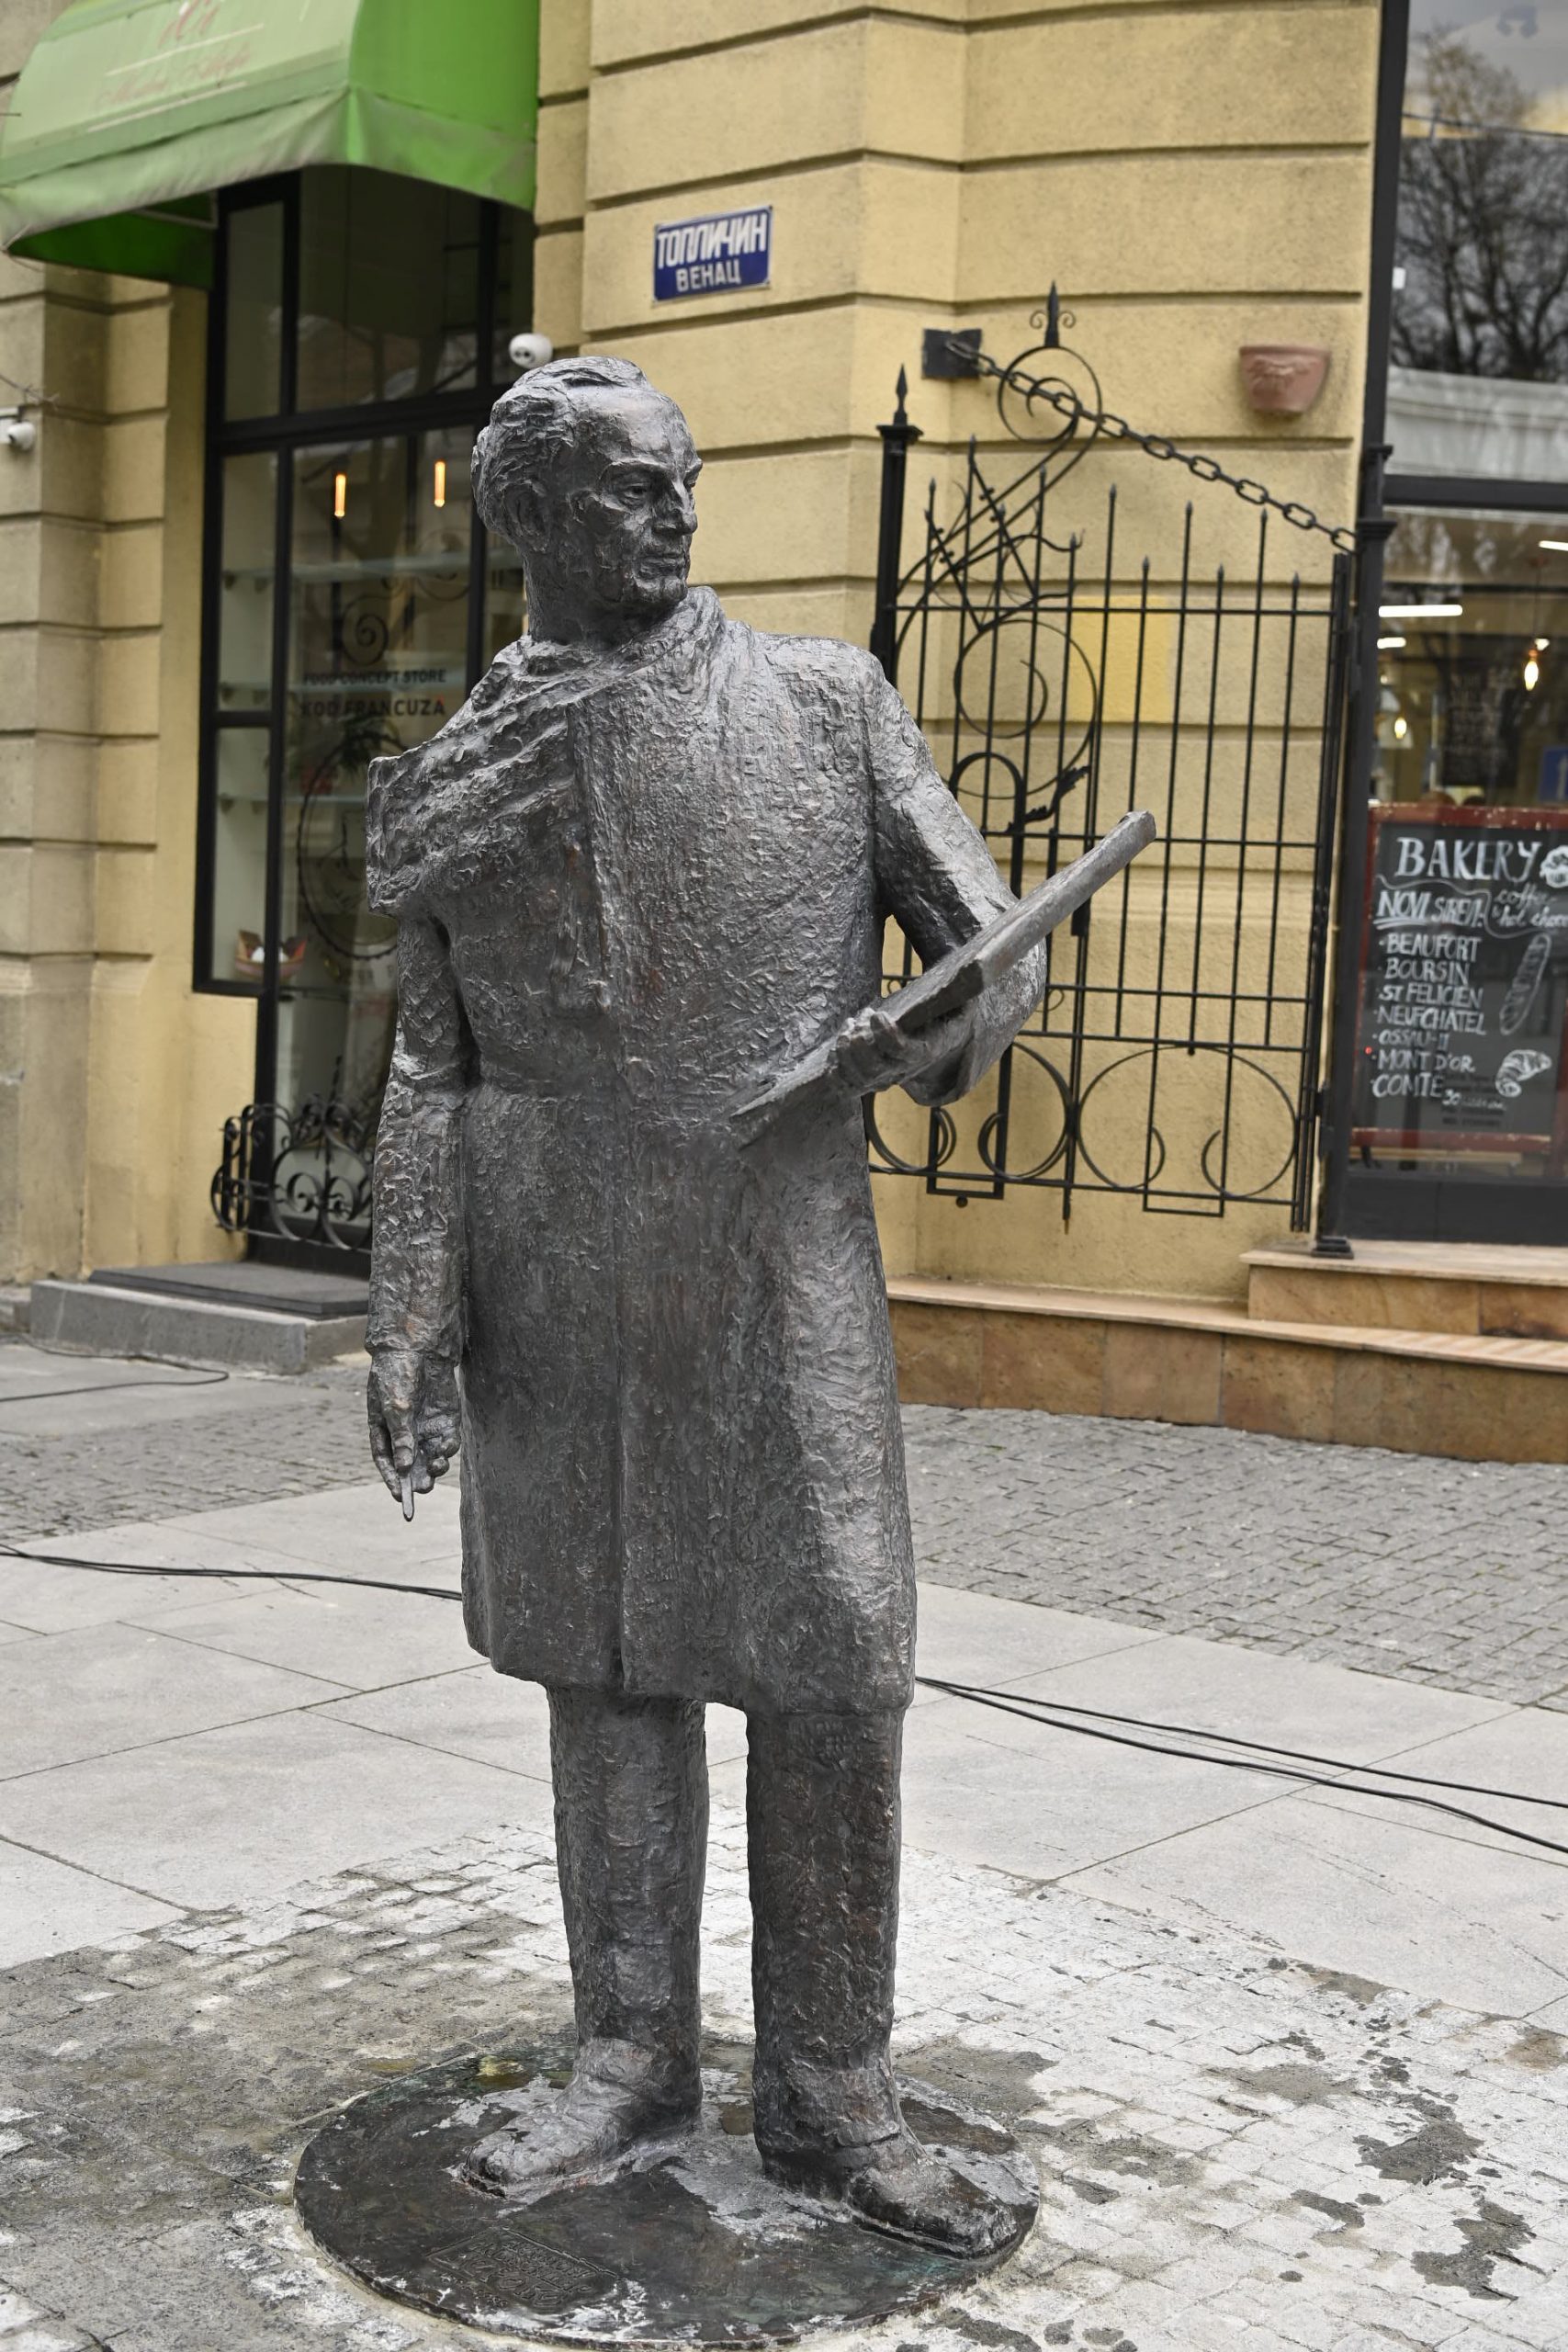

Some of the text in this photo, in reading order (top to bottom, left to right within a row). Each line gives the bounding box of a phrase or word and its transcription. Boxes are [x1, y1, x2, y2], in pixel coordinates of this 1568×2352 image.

[657, 212, 768, 269] ТОПЛИЧИН
[675, 259, 742, 292] ВЕНАЦ
[341, 671, 399, 685] CONCEPT
[401, 669, 447, 684] STORE
[301, 698, 446, 717] KOD FRANCUZA
[1394, 836, 1543, 883] BAKERY
[1378, 889, 1433, 922] NOVI
[1386, 932, 1483, 963] BEAUFORT
[1384, 956, 1471, 986] BOURSIN
[1378, 982, 1484, 1010] ST FELICIEN
[1377, 1004, 1487, 1035] NEUFCHATEL
[1378, 1047, 1432, 1071] MONT
